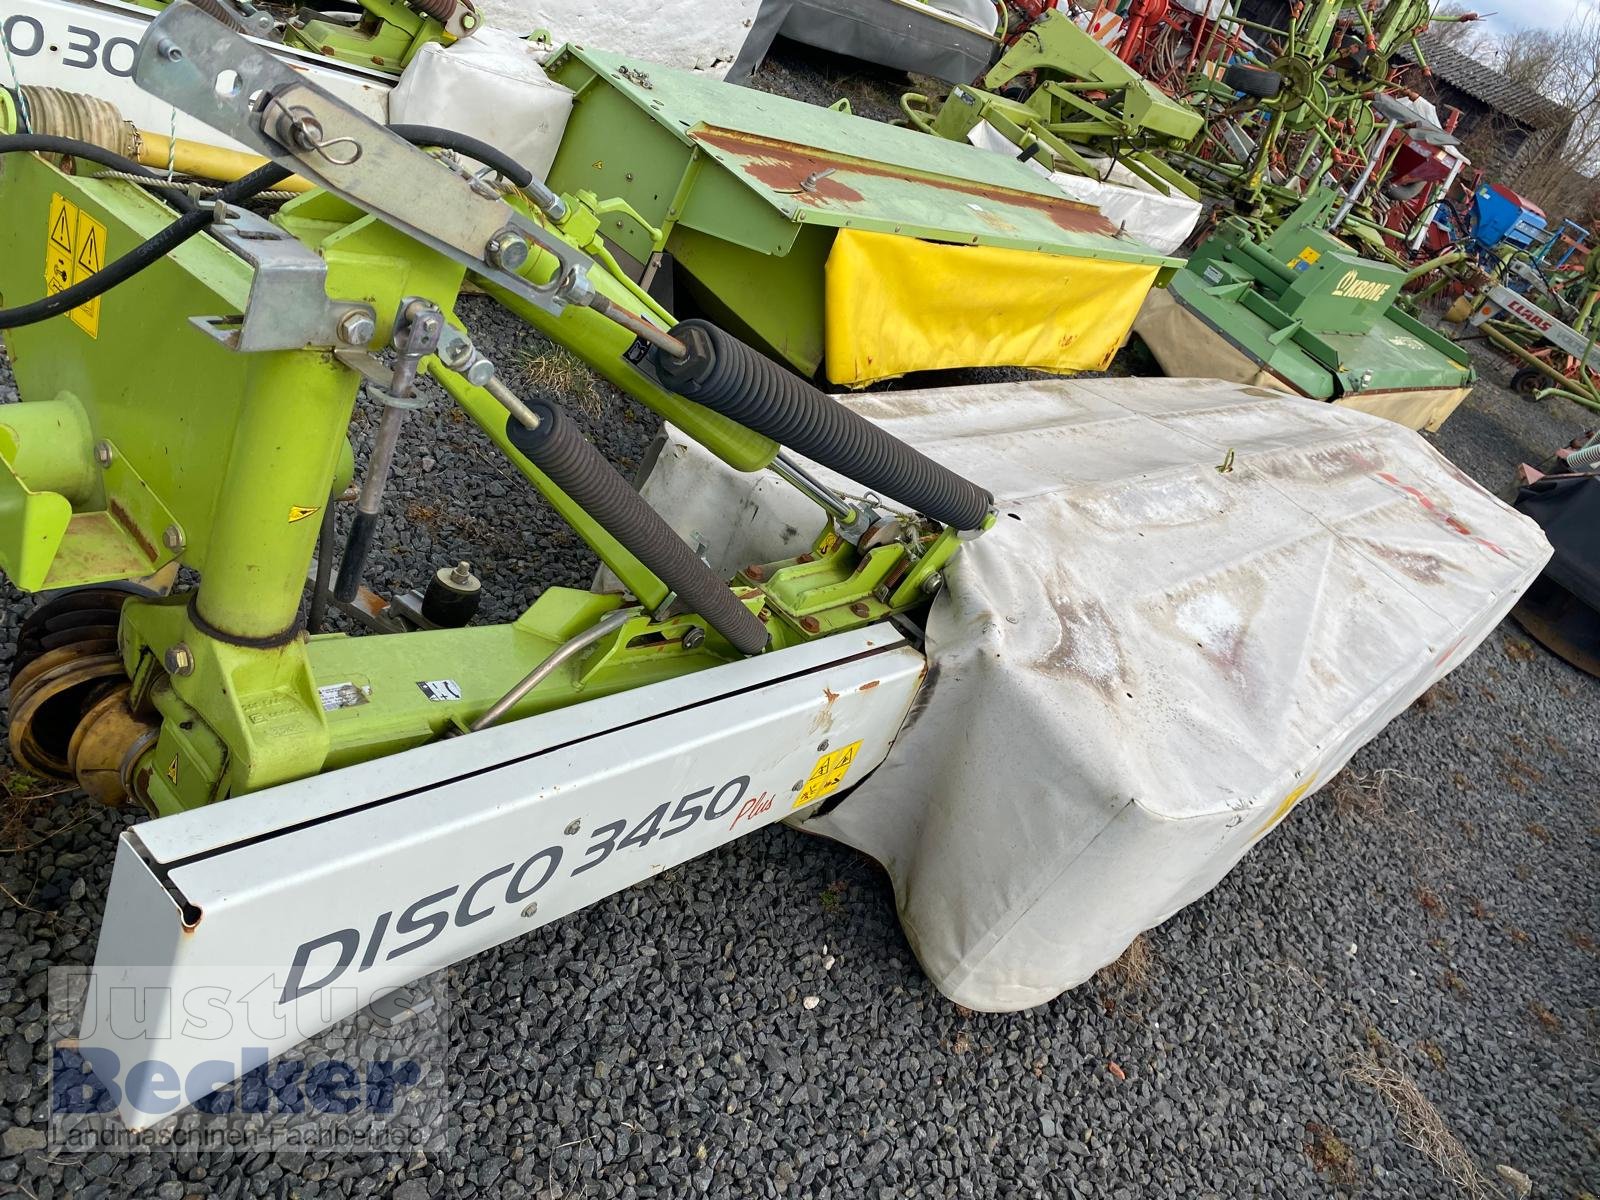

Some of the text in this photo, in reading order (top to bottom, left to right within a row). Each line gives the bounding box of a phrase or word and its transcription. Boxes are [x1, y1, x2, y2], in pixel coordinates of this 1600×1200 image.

[1342, 279, 1391, 302] KRONE
[1507, 300, 1552, 331] CLAAS
[278, 774, 776, 1006] DISCO 3450 Plus
